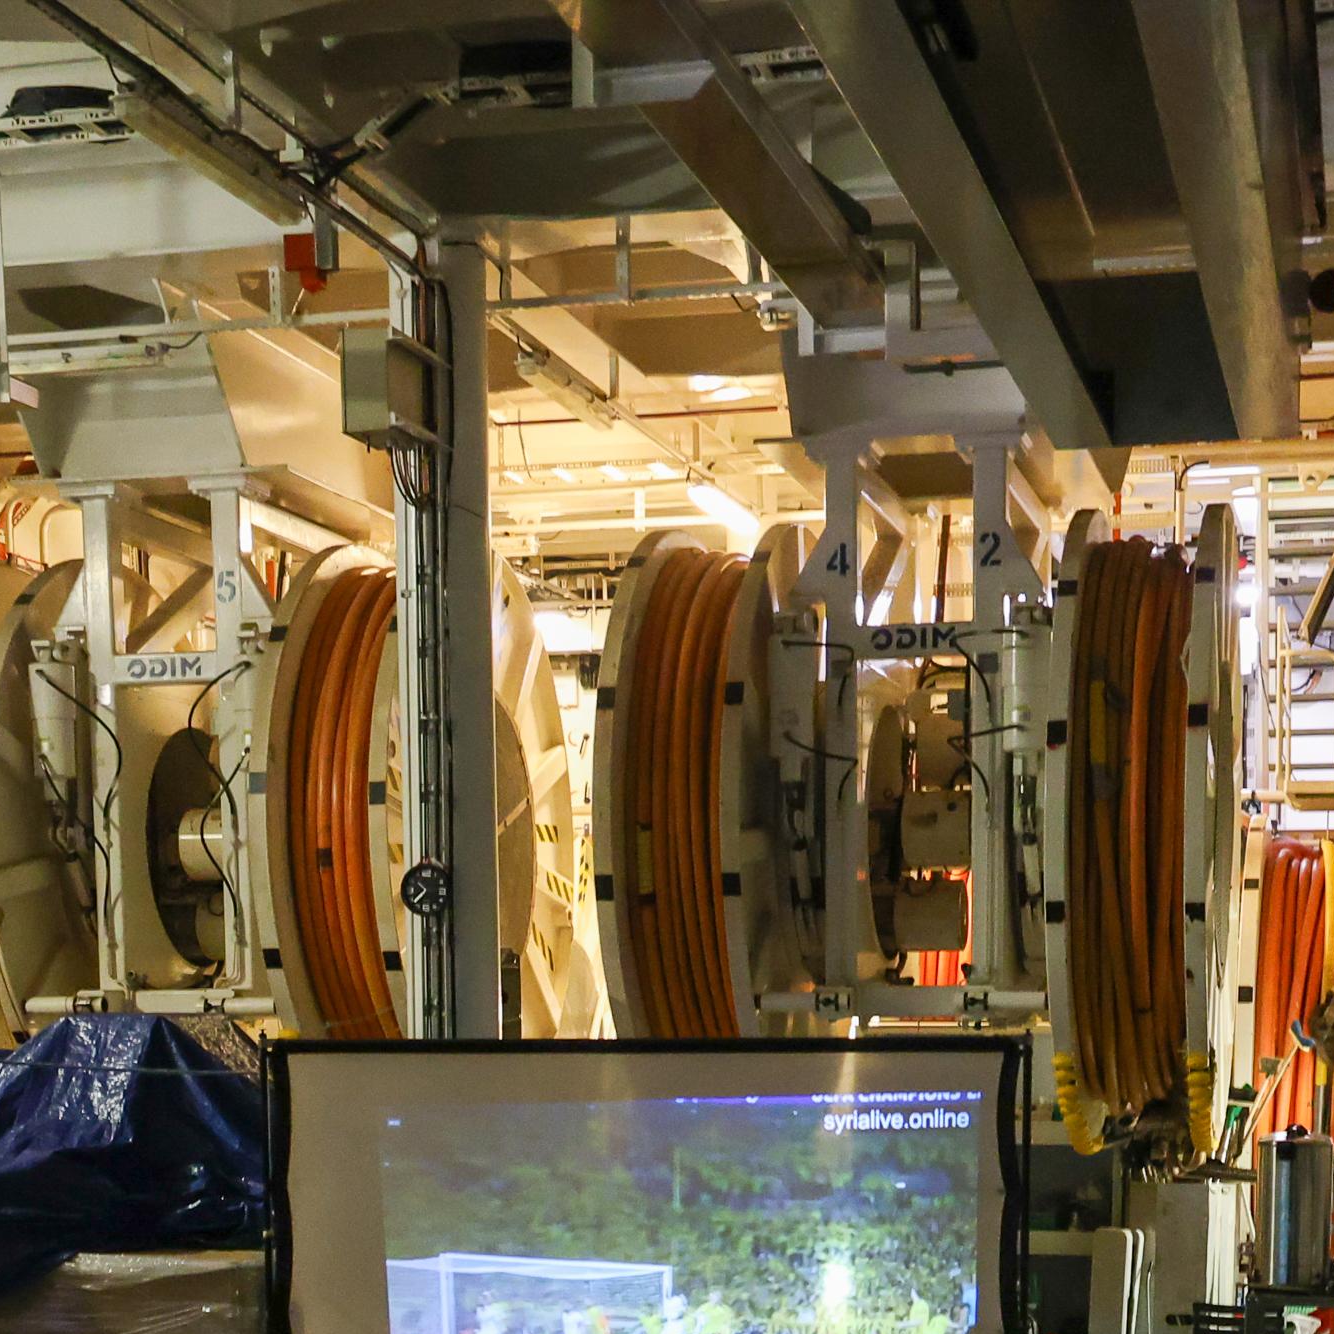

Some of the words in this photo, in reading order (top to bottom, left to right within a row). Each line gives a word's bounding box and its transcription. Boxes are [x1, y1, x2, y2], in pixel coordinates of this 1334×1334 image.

[826, 542, 850, 576] 4
[979, 532, 1002, 567] 2
[217, 570, 236, 604] 5
[870, 626, 956, 650] ODIM
[127, 656, 202, 679] ODIM
[823, 1107, 970, 1136] syrialive.online
